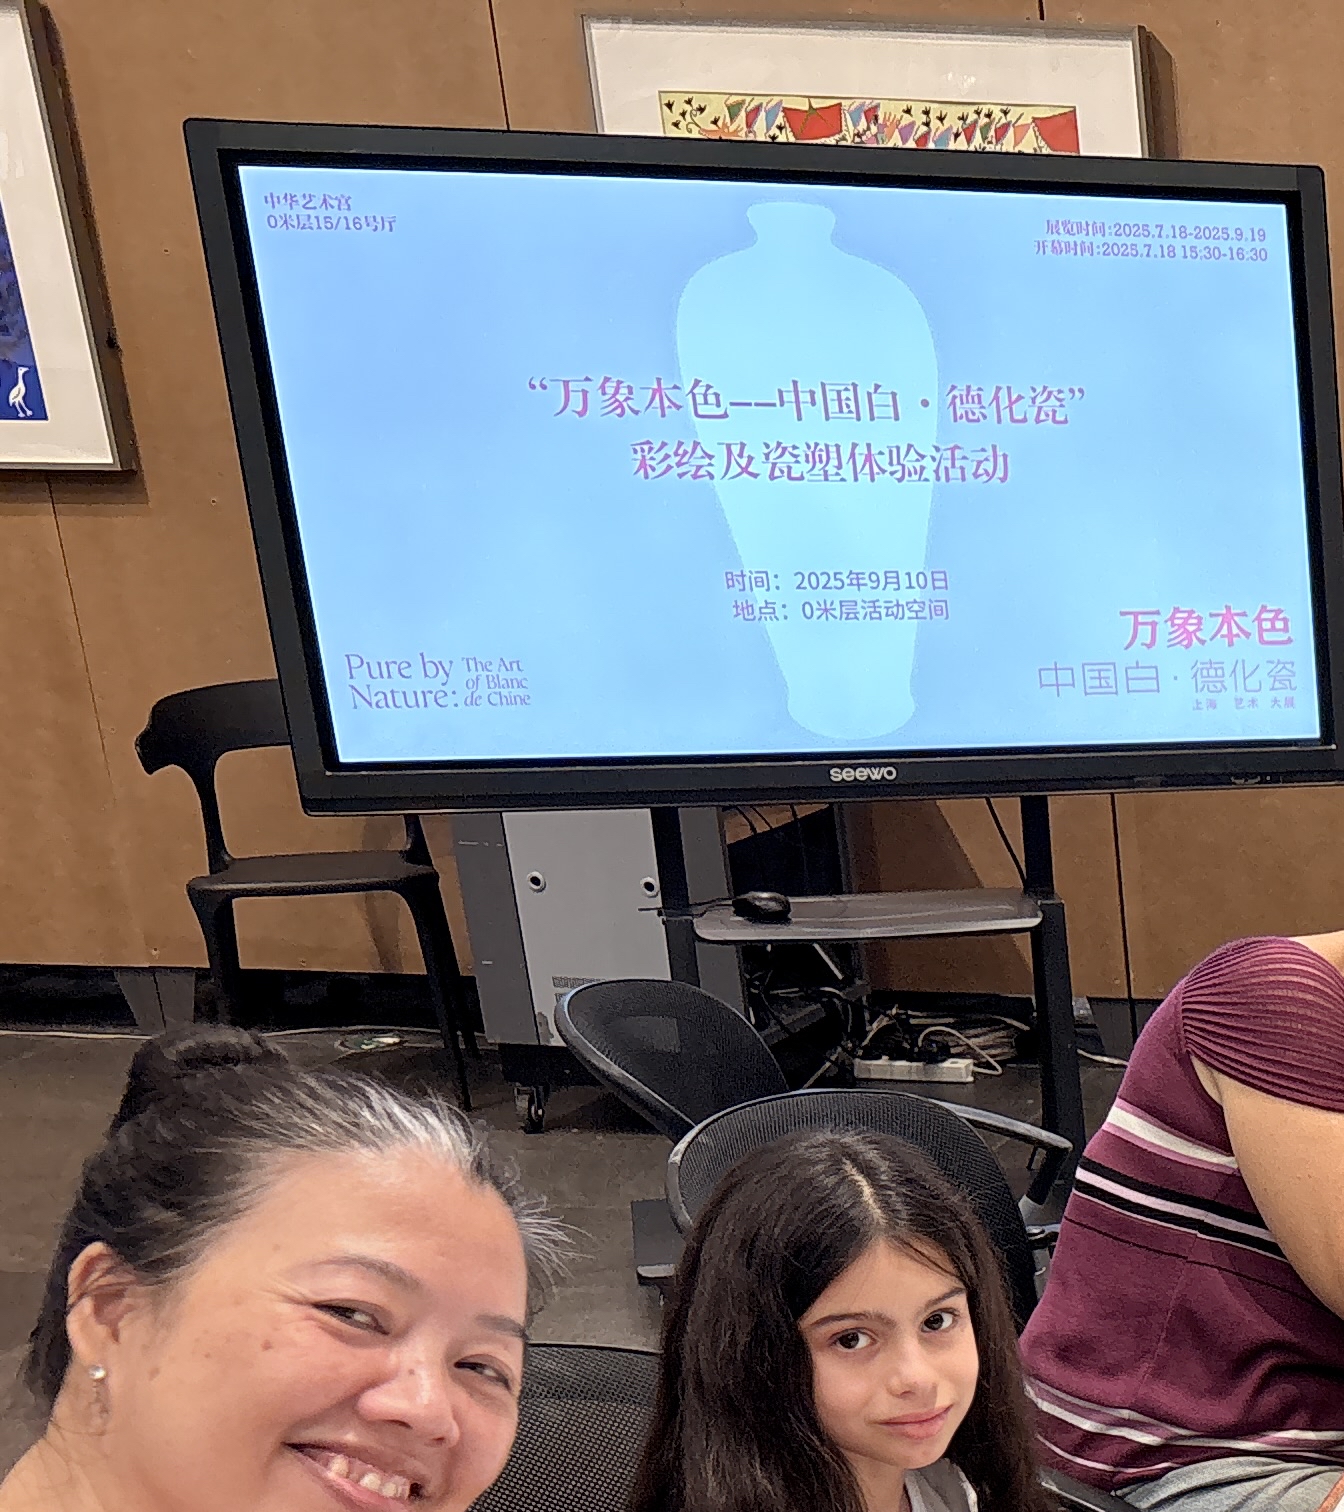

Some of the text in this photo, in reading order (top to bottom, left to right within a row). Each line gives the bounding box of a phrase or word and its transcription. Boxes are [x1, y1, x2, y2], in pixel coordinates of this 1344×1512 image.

[264, 192, 352, 211] 中华艺术宫
[630, 439, 1010, 485] 彩绘及瓷塑体验活动
[1119, 604, 1294, 650] 万象本色
[345, 652, 453, 686] Pure by
[461, 656, 524, 673] The Art
[465, 673, 529, 692] of Blanc
[348, 684, 459, 710] Nature:
[463, 690, 531, 707] de Chine
[829, 766, 898, 782] seewo
